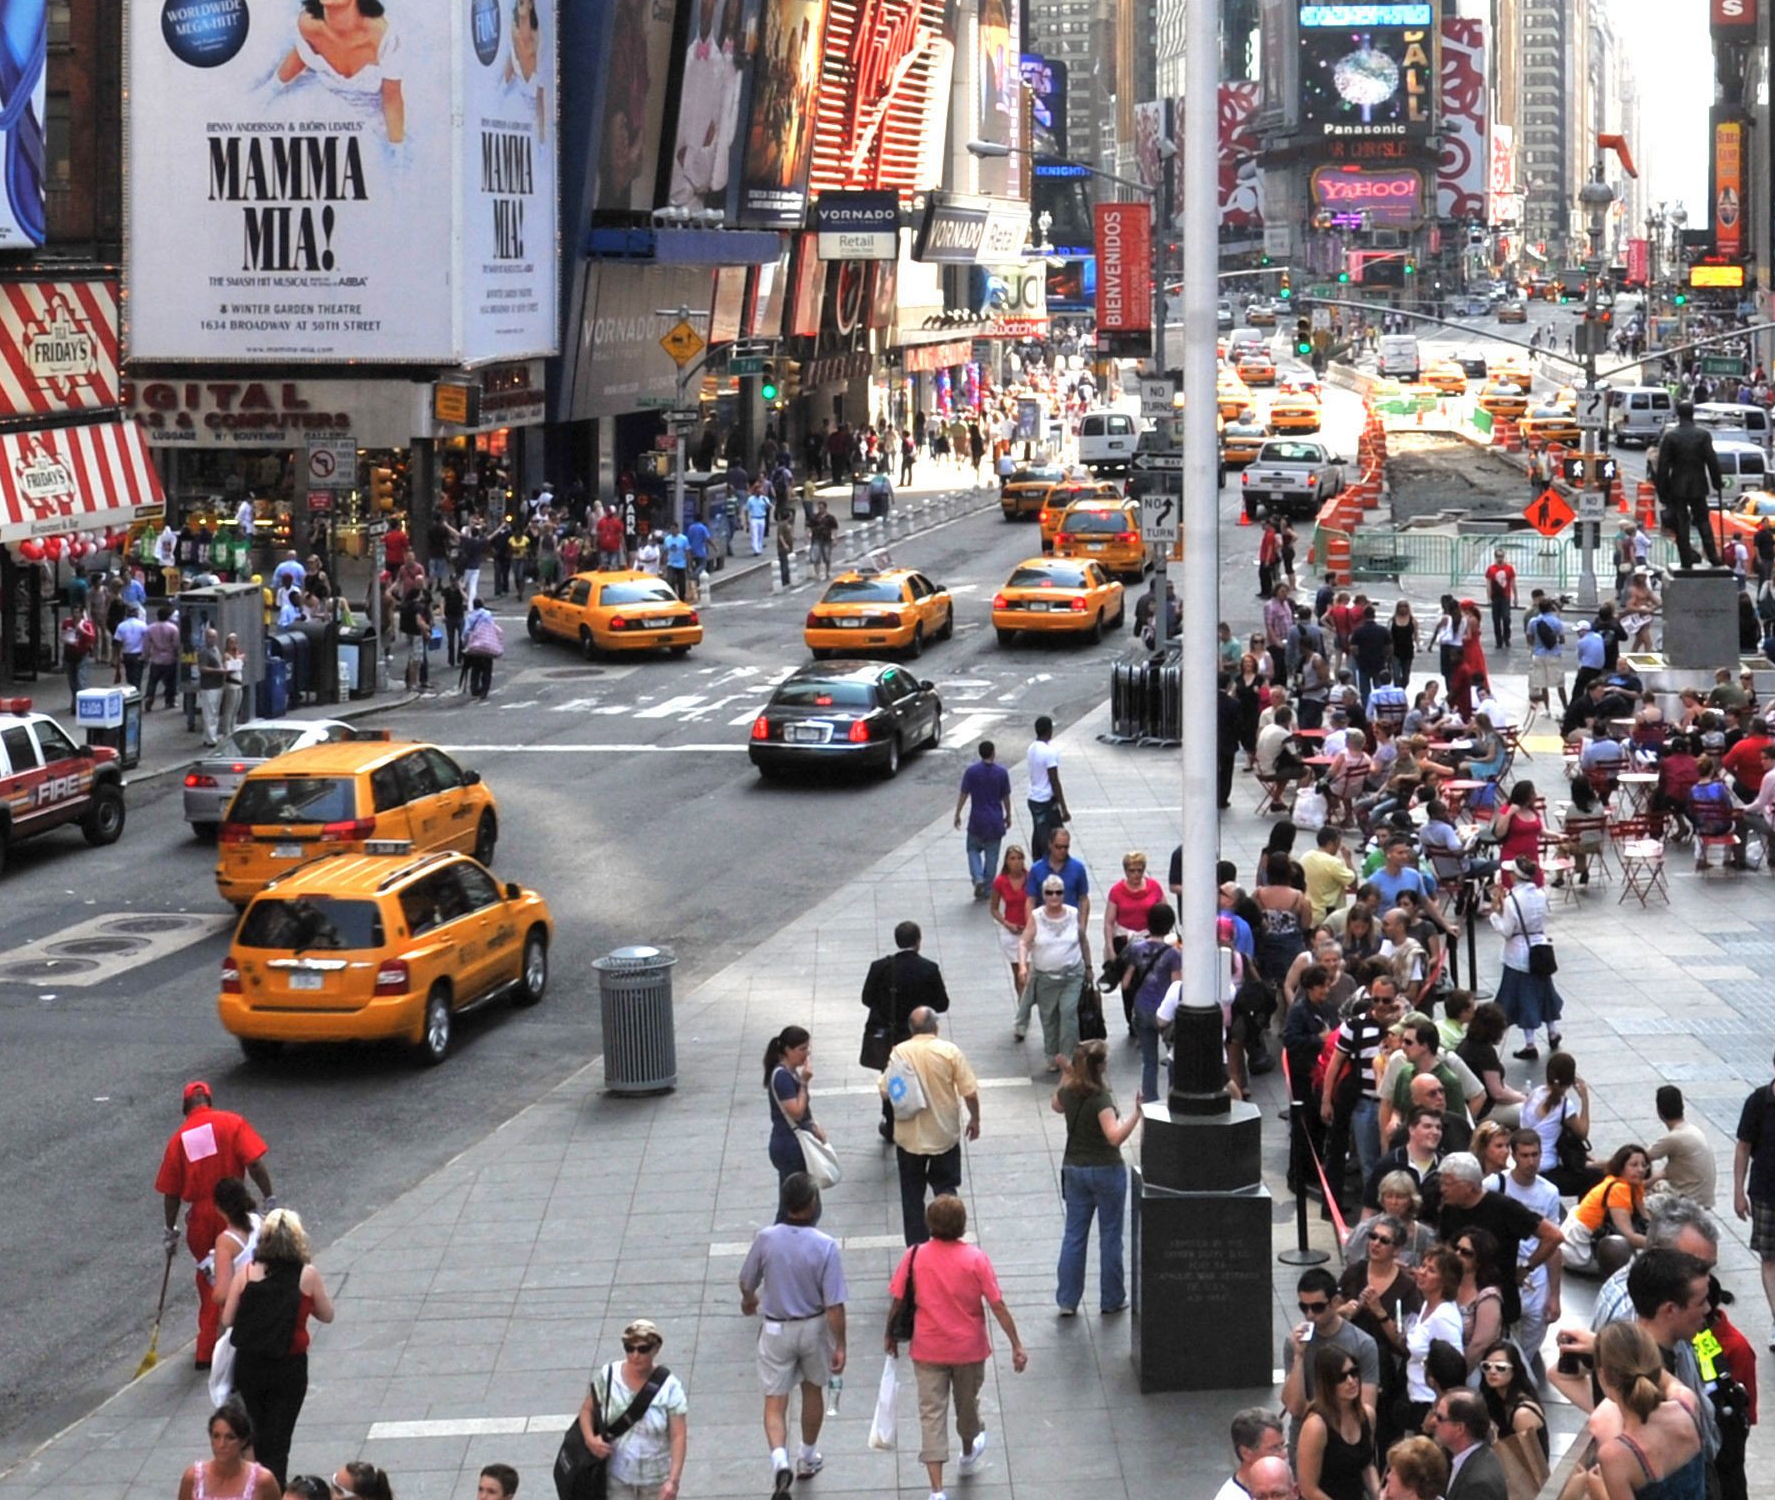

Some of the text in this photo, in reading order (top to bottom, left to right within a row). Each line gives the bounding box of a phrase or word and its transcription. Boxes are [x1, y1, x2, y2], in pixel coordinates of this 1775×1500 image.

[1324, 123, 1407, 135] Panasonic
[207, 136, 368, 201] MAMMA
[481, 131, 533, 195] MAMMA
[1318, 180, 1416, 199] YAHOO!
[820, 209, 895, 221] VORNADO
[242, 204, 336, 273] MIA!
[838, 234, 875, 248] Retail
[1105, 210, 1121, 327] BIENVENIDOS
[273, 276, 308, 287] MUSICAL
[231, 303, 362, 315] WINTER GARDEN THEATRE
[200, 320, 382, 332] 1634 BROADWAY AT 50TH STREET
[34, 338, 88, 363] FRIDAY'S
[1149, 386, 1166, 398] NO
[204, 412, 351, 430] COMPUTERS
[626, 493, 635, 536] PARK
[1146, 526, 1175, 539] TURN
[38, 773, 81, 805] FIRE
